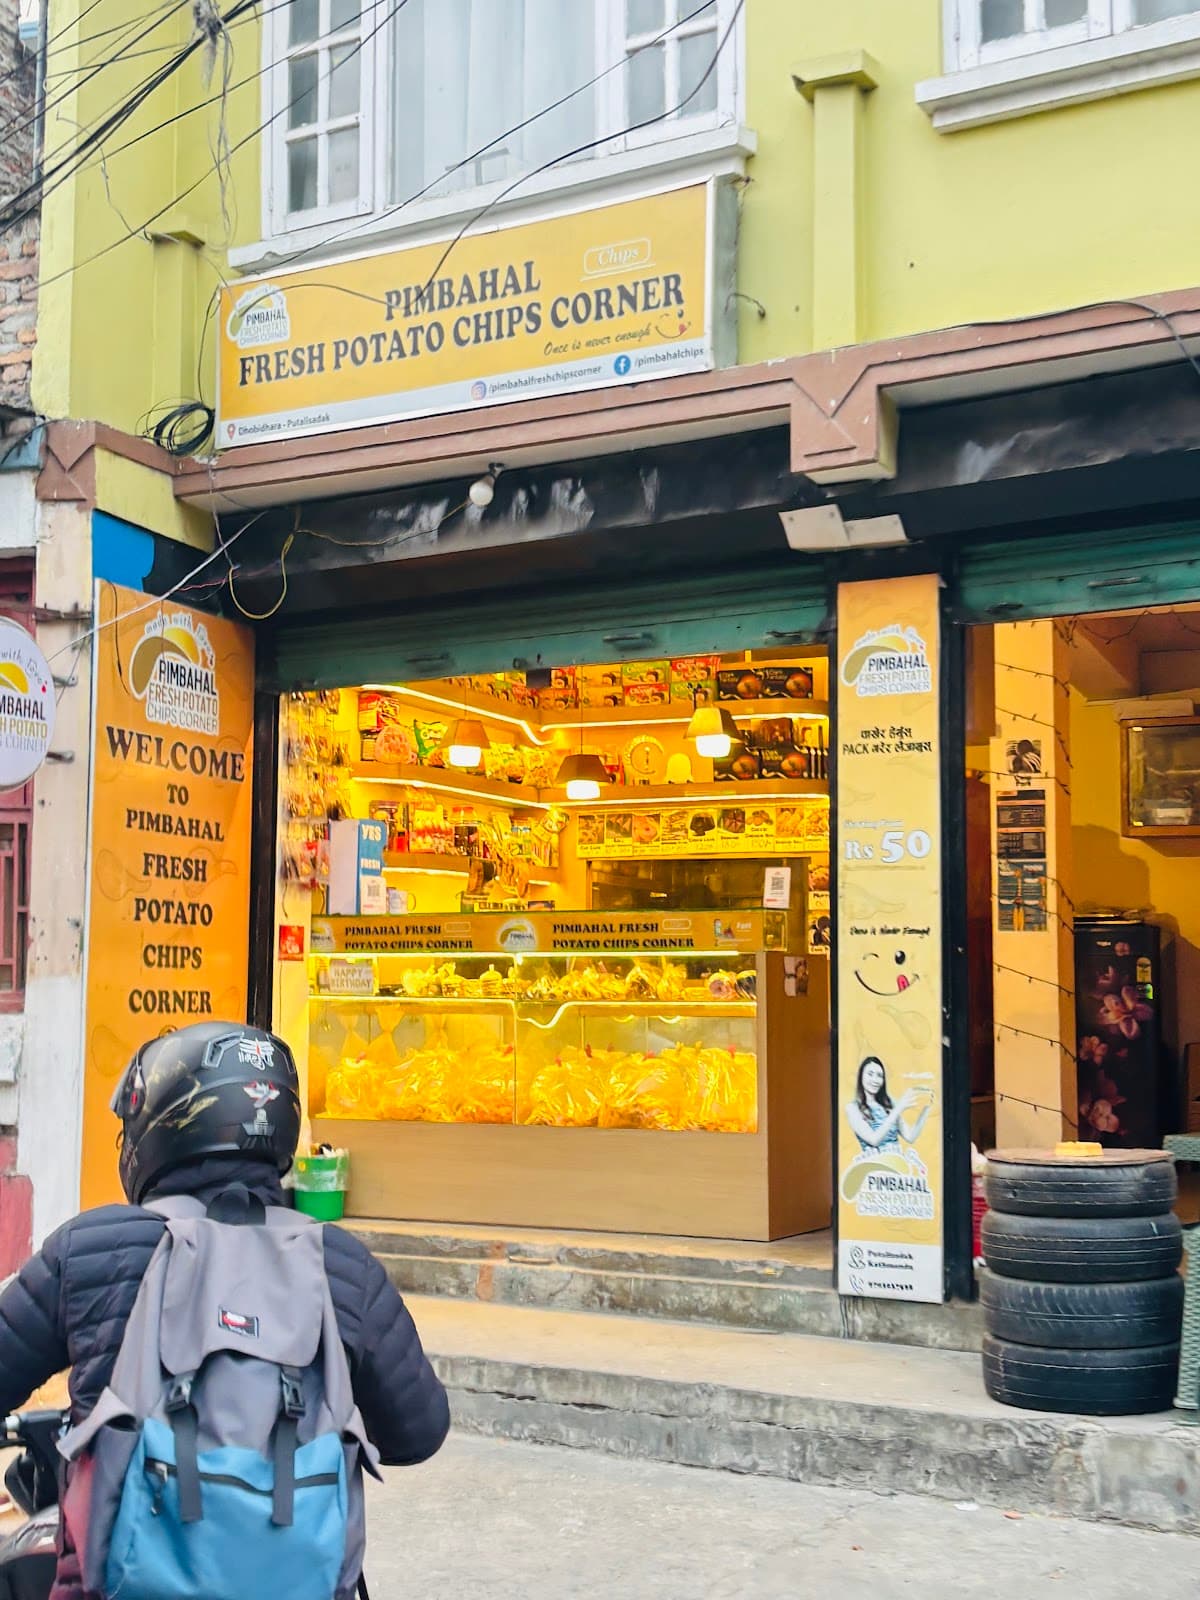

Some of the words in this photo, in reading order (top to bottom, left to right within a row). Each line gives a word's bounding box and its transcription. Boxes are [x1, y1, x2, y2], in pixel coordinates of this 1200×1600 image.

[597, 247, 639, 266] Chips
[384, 260, 542, 321] PIMBAHAL
[238, 342, 325, 387] FRESH
[333, 321, 445, 370] POTATO
[453, 302, 542, 347] CHIPS
[550, 273, 684, 329] CORNER
[246, 309, 286, 327] PIMBAHAL
[543, 341, 568, 356] Once
[571, 339, 582, 351] is
[585, 336, 612, 348] never
[634, 347, 705, 368] /pimbahalchips
[868, 654, 929, 672] PIMBAHAL
[158, 659, 217, 696] PIMBAHAL
[0, 693, 46, 721] MBAHAL
[149, 682, 183, 707] FRESH
[183, 689, 218, 715] POTATO
[9, 718, 48, 739] POTATO
[147, 703, 178, 724] CHIPS
[178, 709, 218, 733] CORNER
[106, 725, 245, 783] WELCOME
[842, 743, 870, 755] PACK
[166, 783, 189, 806] TO
[125, 808, 225, 842] PIMBAHAL
[844, 839, 873, 860] Rs
[880, 829, 932, 864] 50
[142, 852, 208, 883] FRESH
[134, 897, 214, 927] POTATO
[344, 926, 400, 936] PIMBAHAL
[404, 924, 442, 935] FRESH
[552, 922, 617, 935] PIMBAHAL
[619, 922, 659, 933] FRESH
[344, 939, 388, 950] POTATO
[390, 939, 424, 949] CHIPS
[426, 938, 473, 949] CORNER
[552, 938, 601, 949] POTATO
[603, 938, 639, 948] CHIPS
[642, 937, 695, 948] CORNER
[143, 943, 203, 970] CHIPS
[128, 988, 212, 1014] CORNER
[867, 1175, 931, 1193] PIMBAHAL
